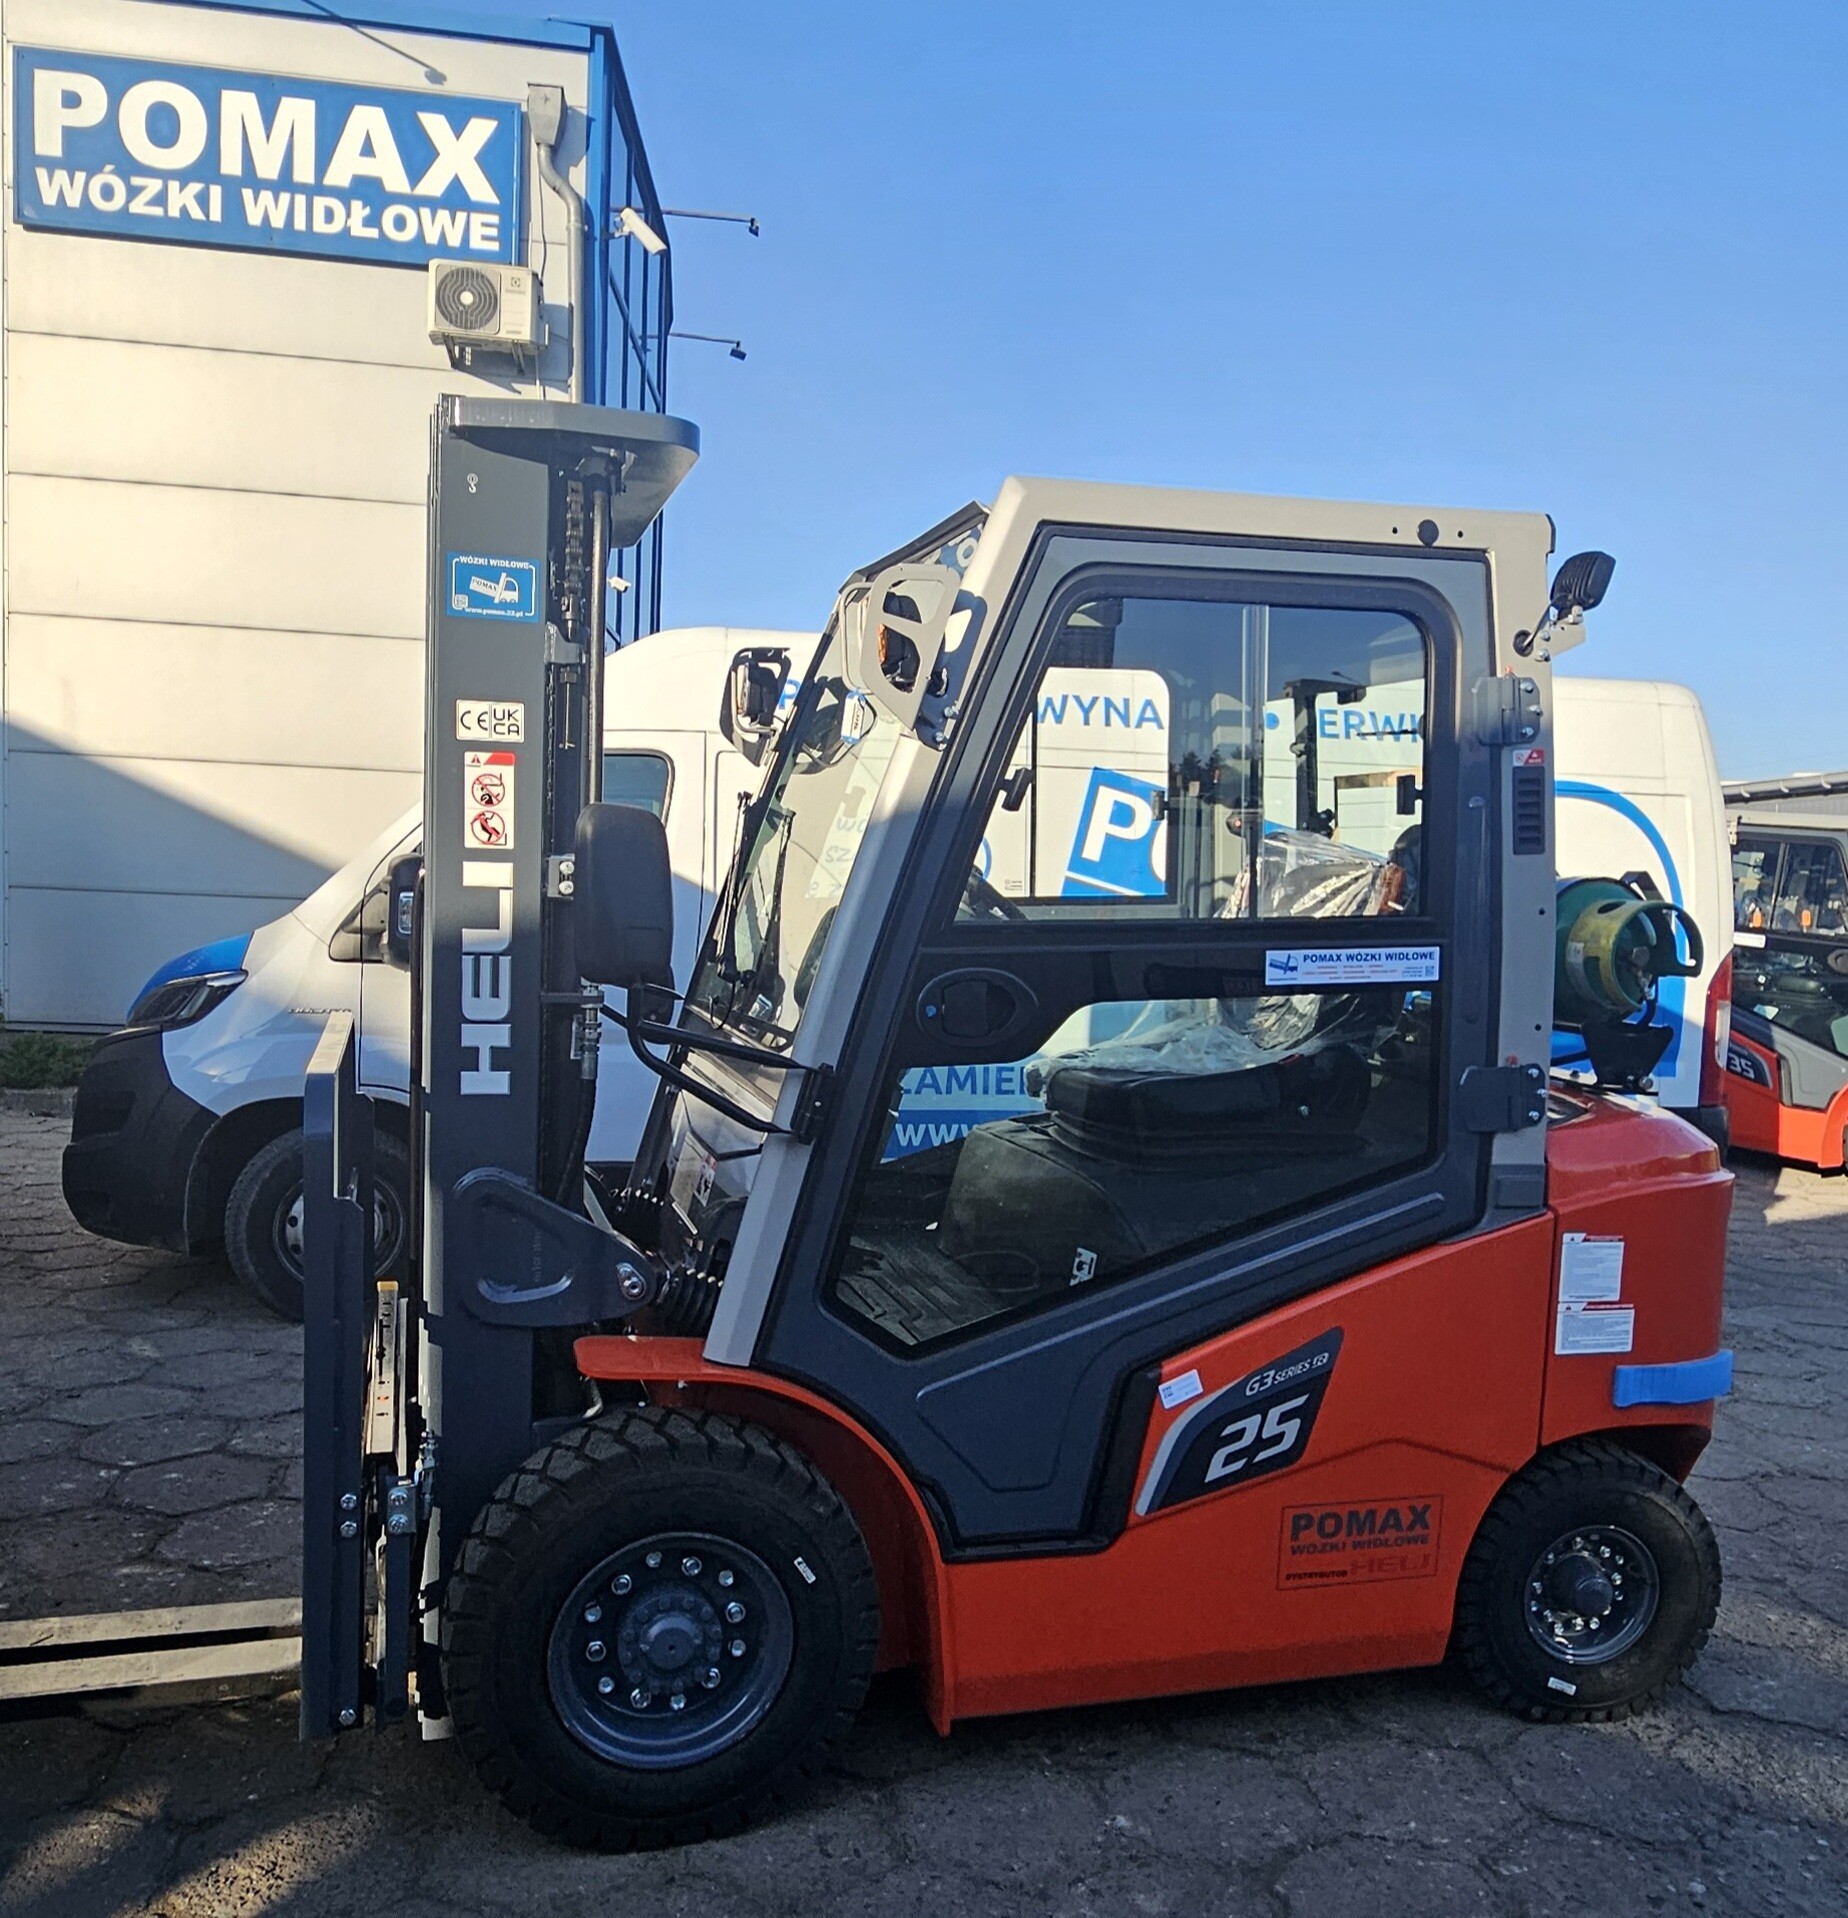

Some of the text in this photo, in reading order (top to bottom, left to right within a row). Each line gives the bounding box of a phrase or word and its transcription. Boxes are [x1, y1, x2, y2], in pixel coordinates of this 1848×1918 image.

[33, 68, 501, 205] POMAX
[35, 165, 501, 252] WÓZKI WIDŁOWE
[459, 555, 530, 570] WÓZKI WIDŁOWE
[460, 710, 489, 731] CE
[493, 708, 519, 722] UK
[493, 722, 520, 736] CA
[1303, 951, 1436, 963] POMAX WÓZKI WIDŁOWE
[460, 860, 514, 1096] HELI
[1728, 1052, 1755, 1079] 35
[1204, 1393, 1310, 1483] 25
[1290, 1504, 1432, 1542] POMAX
